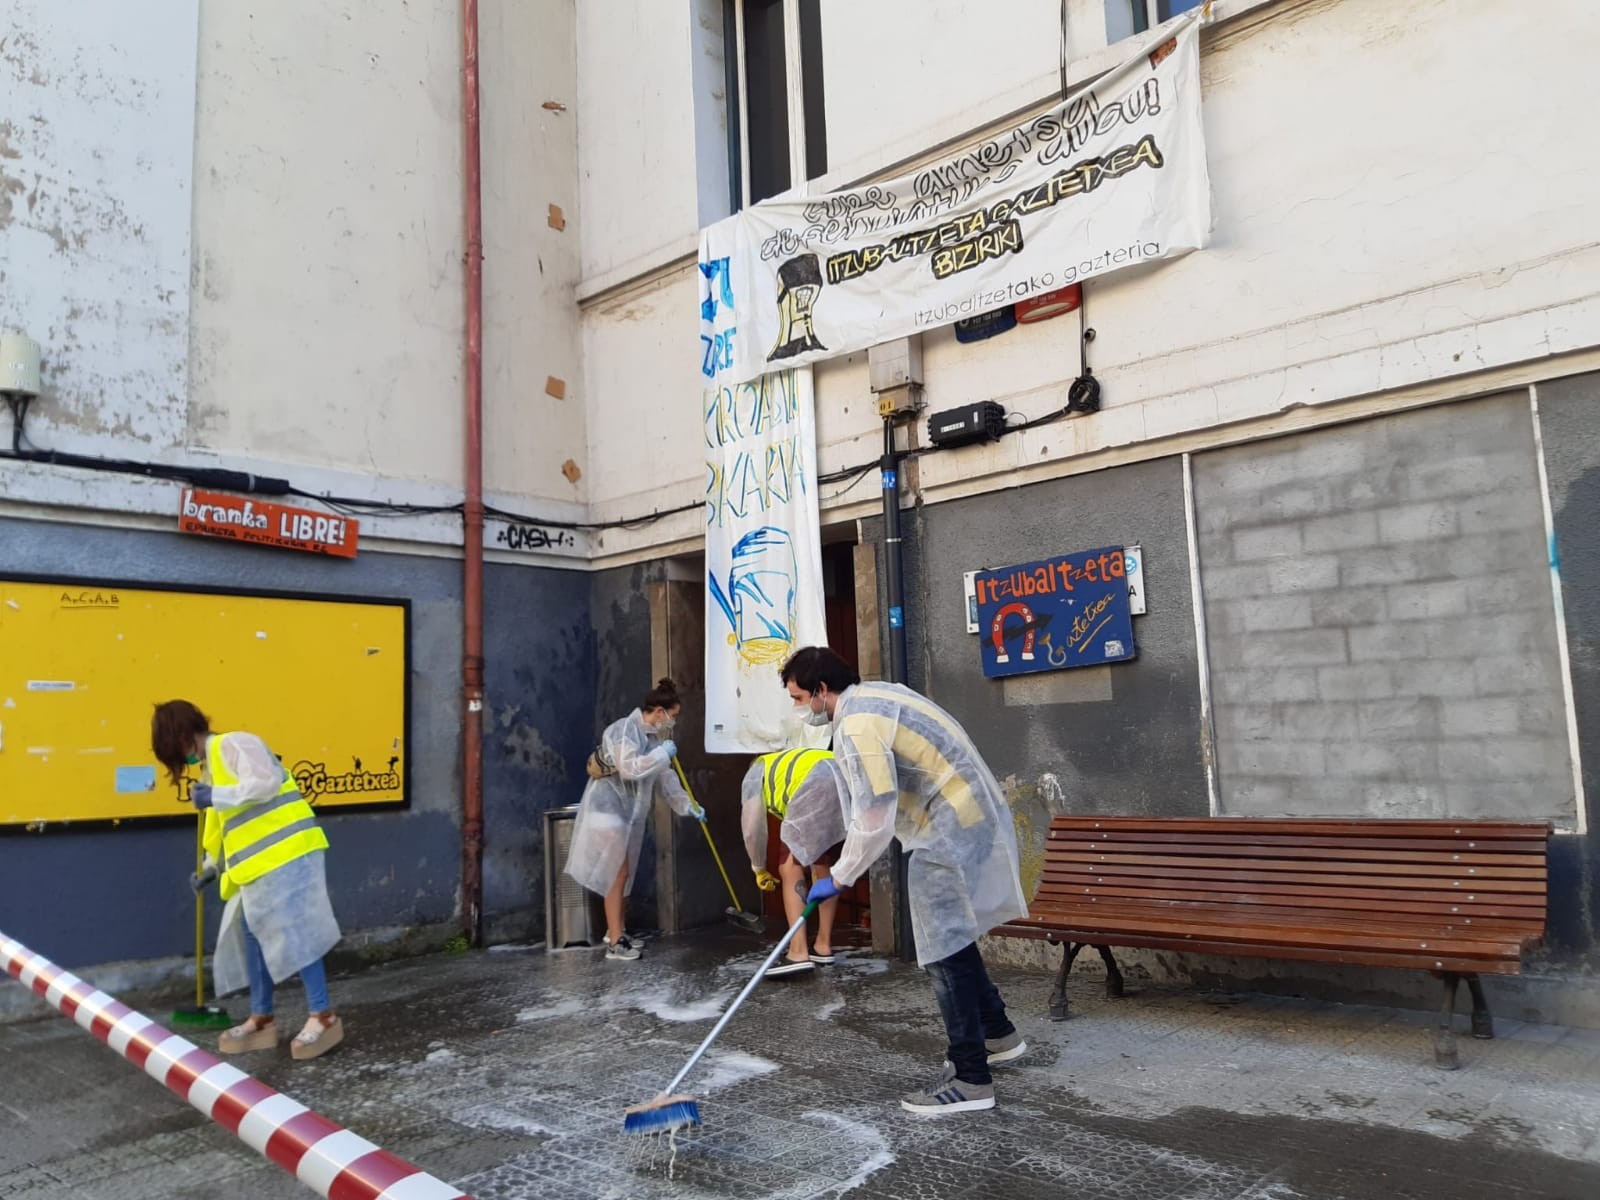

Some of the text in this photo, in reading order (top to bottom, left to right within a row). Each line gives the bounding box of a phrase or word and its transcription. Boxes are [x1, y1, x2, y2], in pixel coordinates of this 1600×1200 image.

[1064, 240, 1160, 282] gazteria
[182, 489, 345, 546] branka LIBRE!
[507, 524, 564, 549] CASH
[976, 551, 1125, 604] Itzubaltzeta
[311, 770, 400, 794] Gaztetxea
